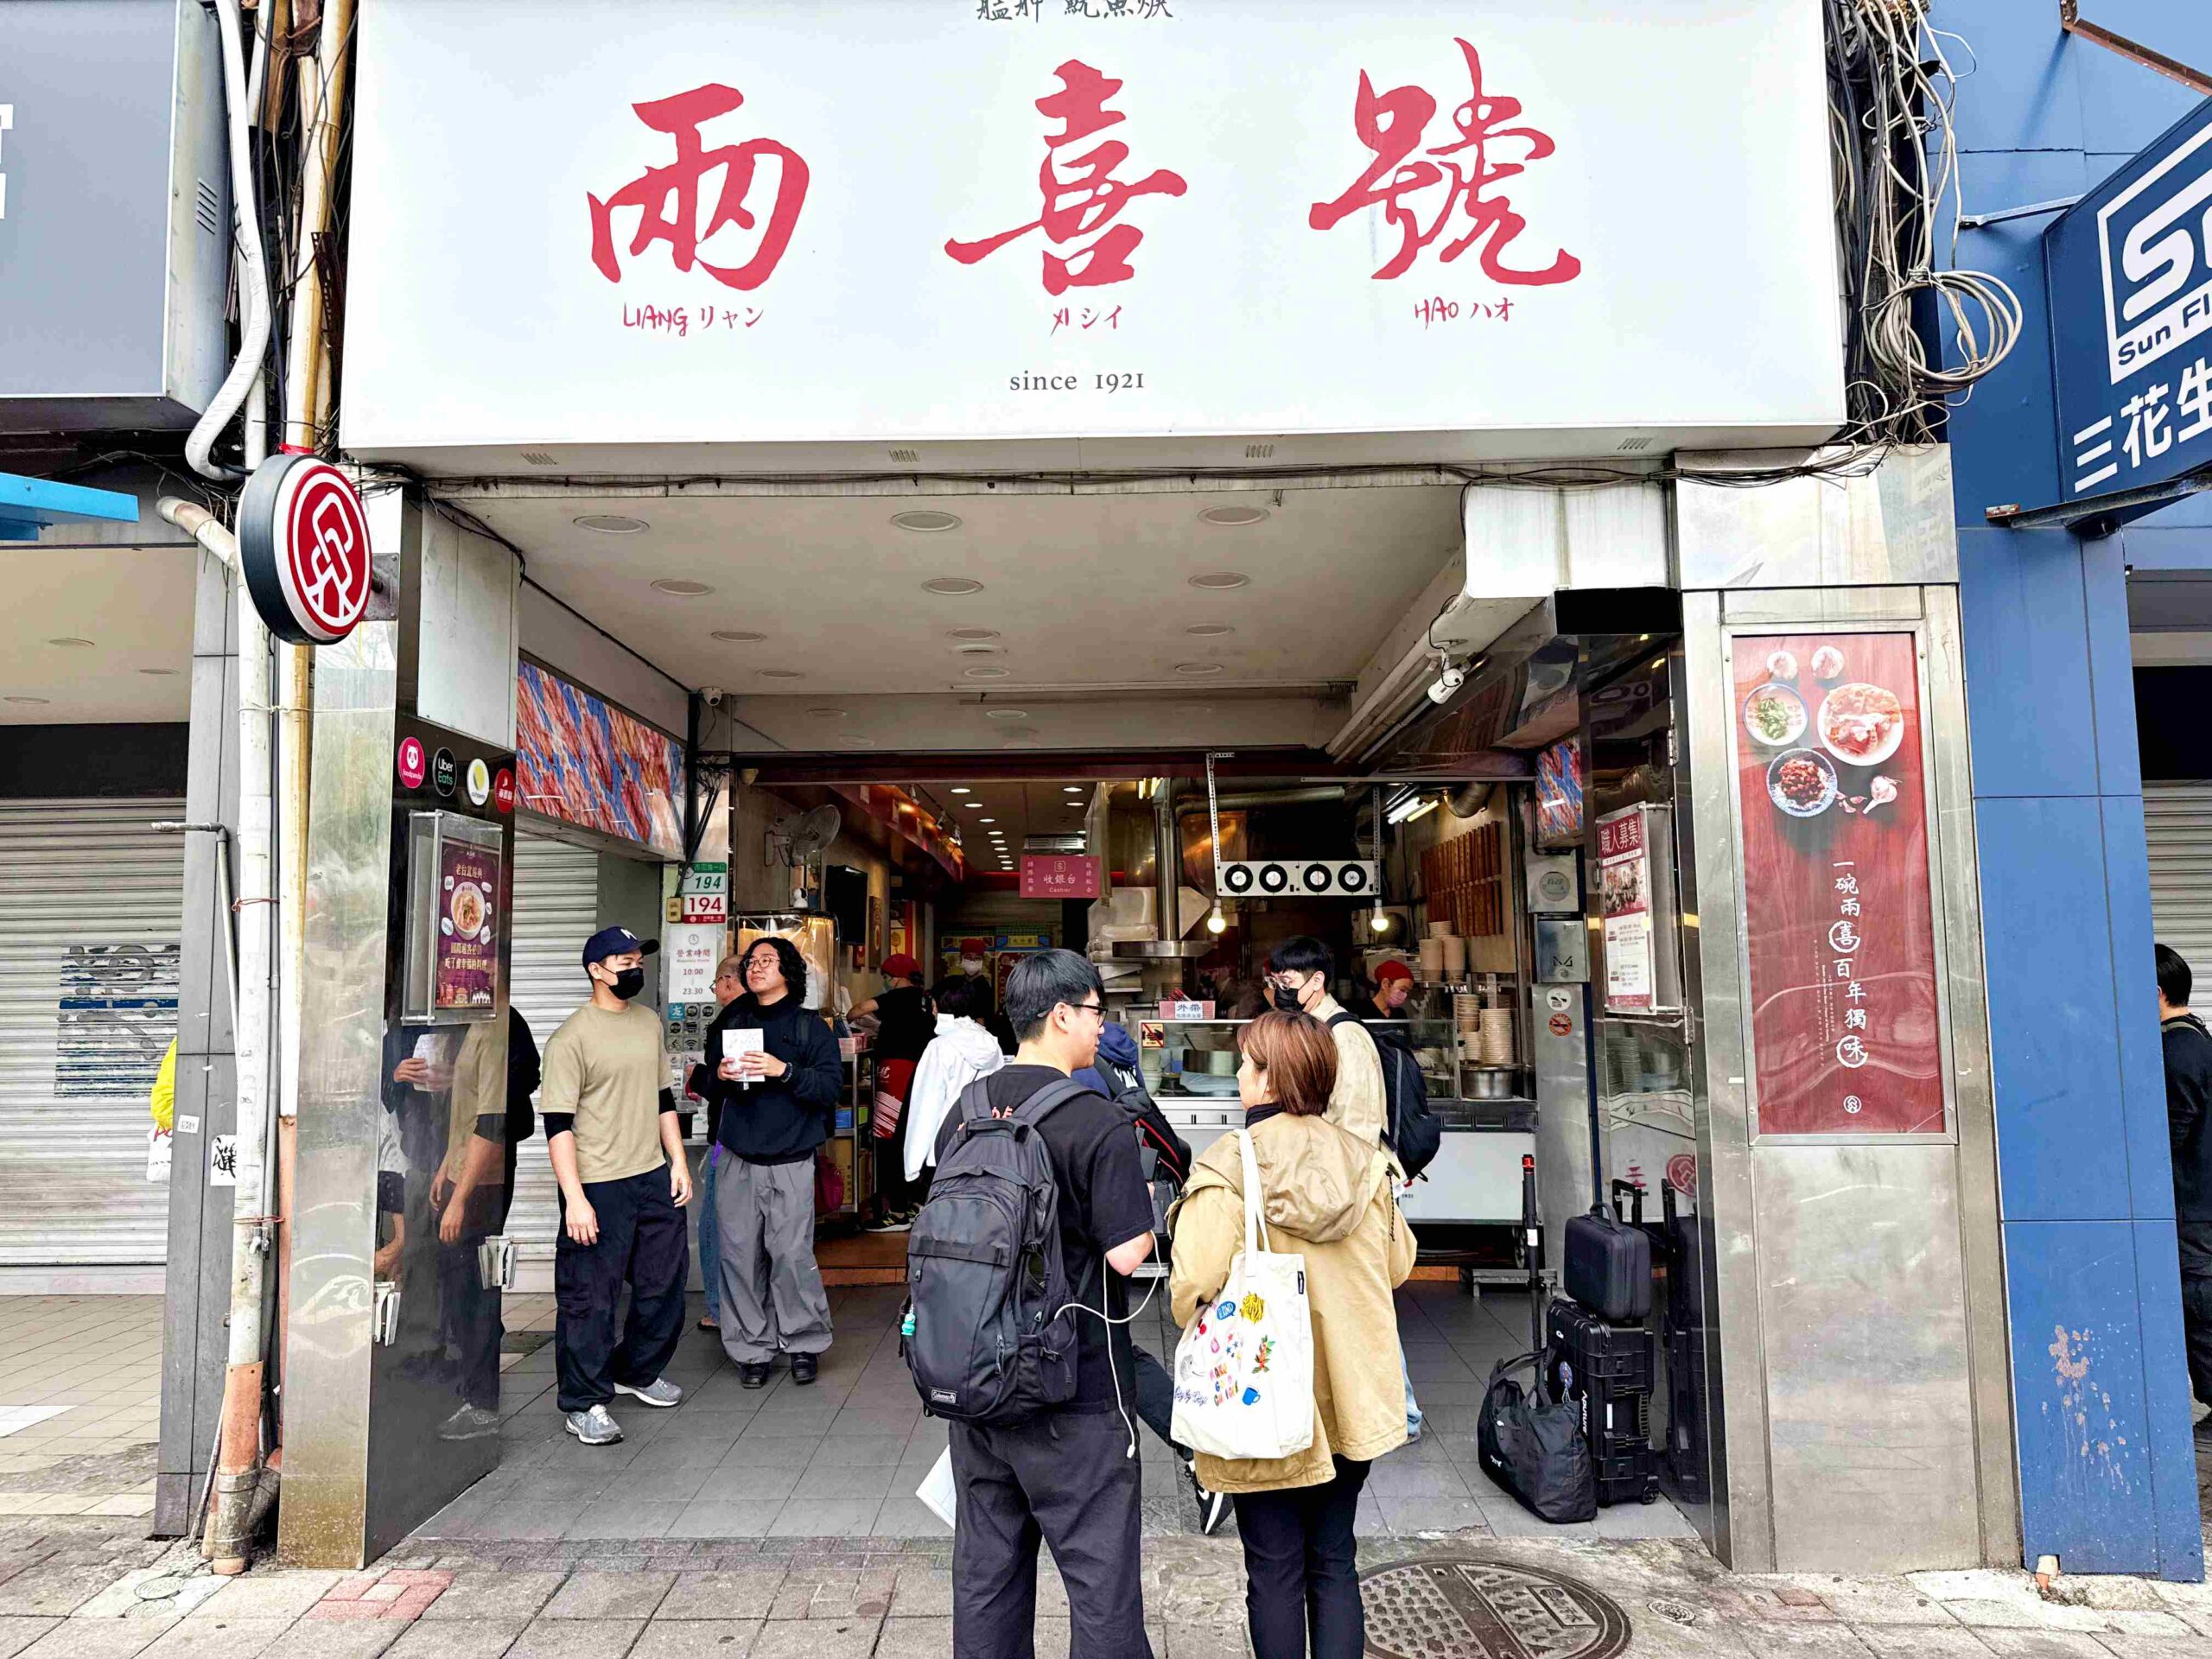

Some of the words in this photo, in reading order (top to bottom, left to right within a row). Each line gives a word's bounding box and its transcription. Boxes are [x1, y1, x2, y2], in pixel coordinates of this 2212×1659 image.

[623, 303, 688, 336] LIANG
[701, 306, 764, 329] リャン
[1081, 305, 1122, 330] シイ
[1414, 297, 1459, 323] HAO
[2118, 325, 2171, 366] Sun
[1009, 371, 1077, 391] since
[1096, 372, 1145, 394] 1921
[2074, 356, 2212, 493] 三花生
[437, 758, 454, 772] Uber
[437, 772, 454, 785] Eats
[695, 875, 721, 889] 194
[1043, 874, 1077, 885] 收銀台
[689, 897, 722, 912] 194
[1580, 1389, 1589, 1437] Aputure
